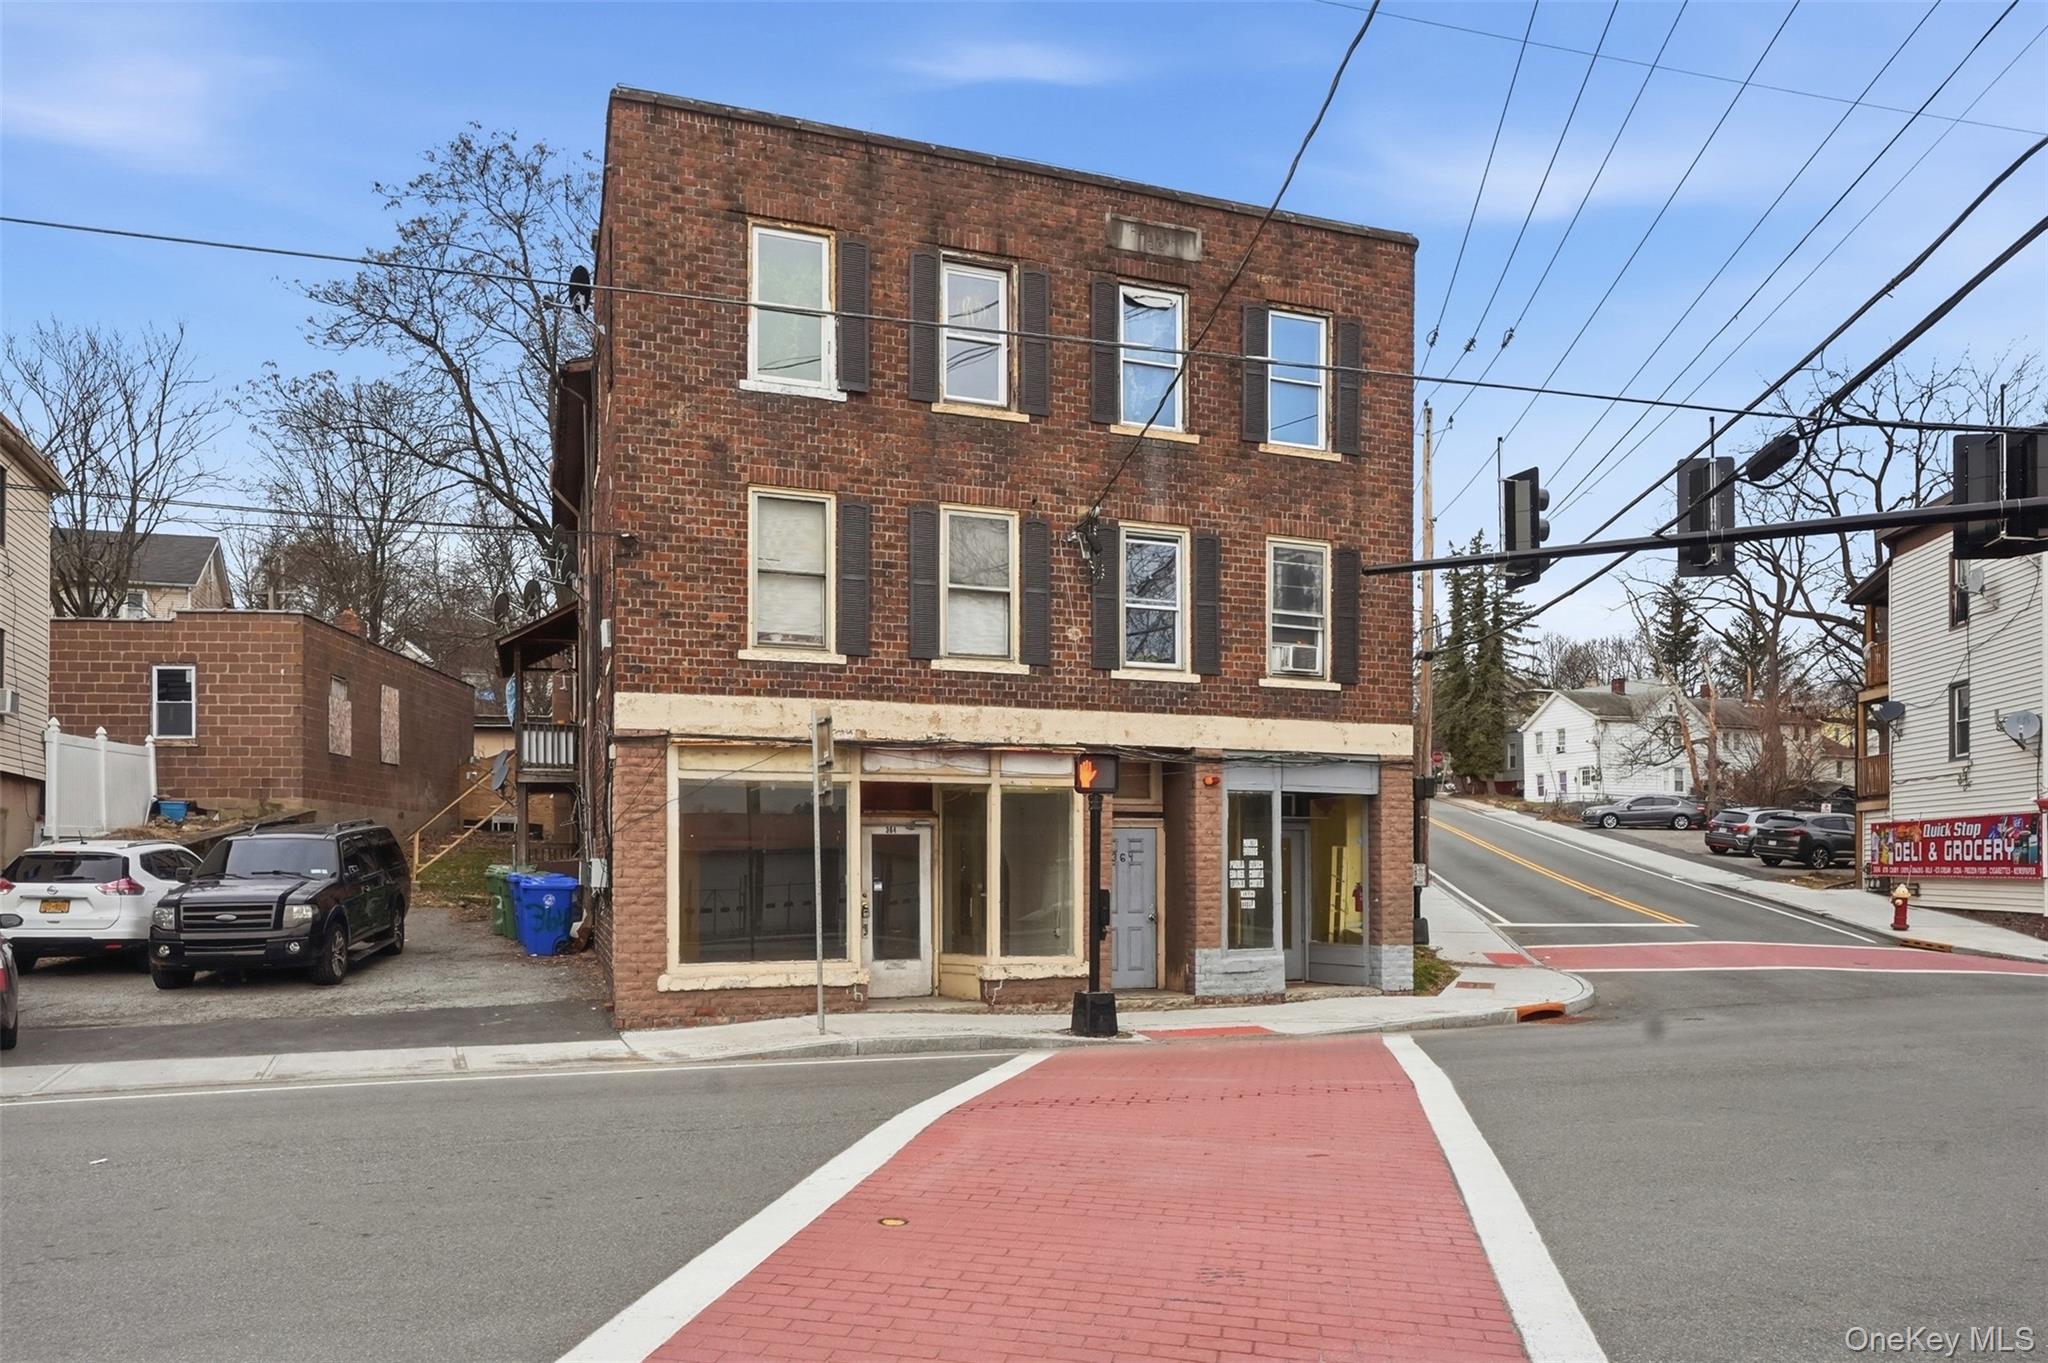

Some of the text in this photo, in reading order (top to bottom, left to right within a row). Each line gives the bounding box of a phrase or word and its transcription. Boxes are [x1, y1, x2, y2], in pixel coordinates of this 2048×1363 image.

[1923, 822, 1981, 838] Quick Stop
[1894, 838, 2015, 862] DELI & GROCERY
